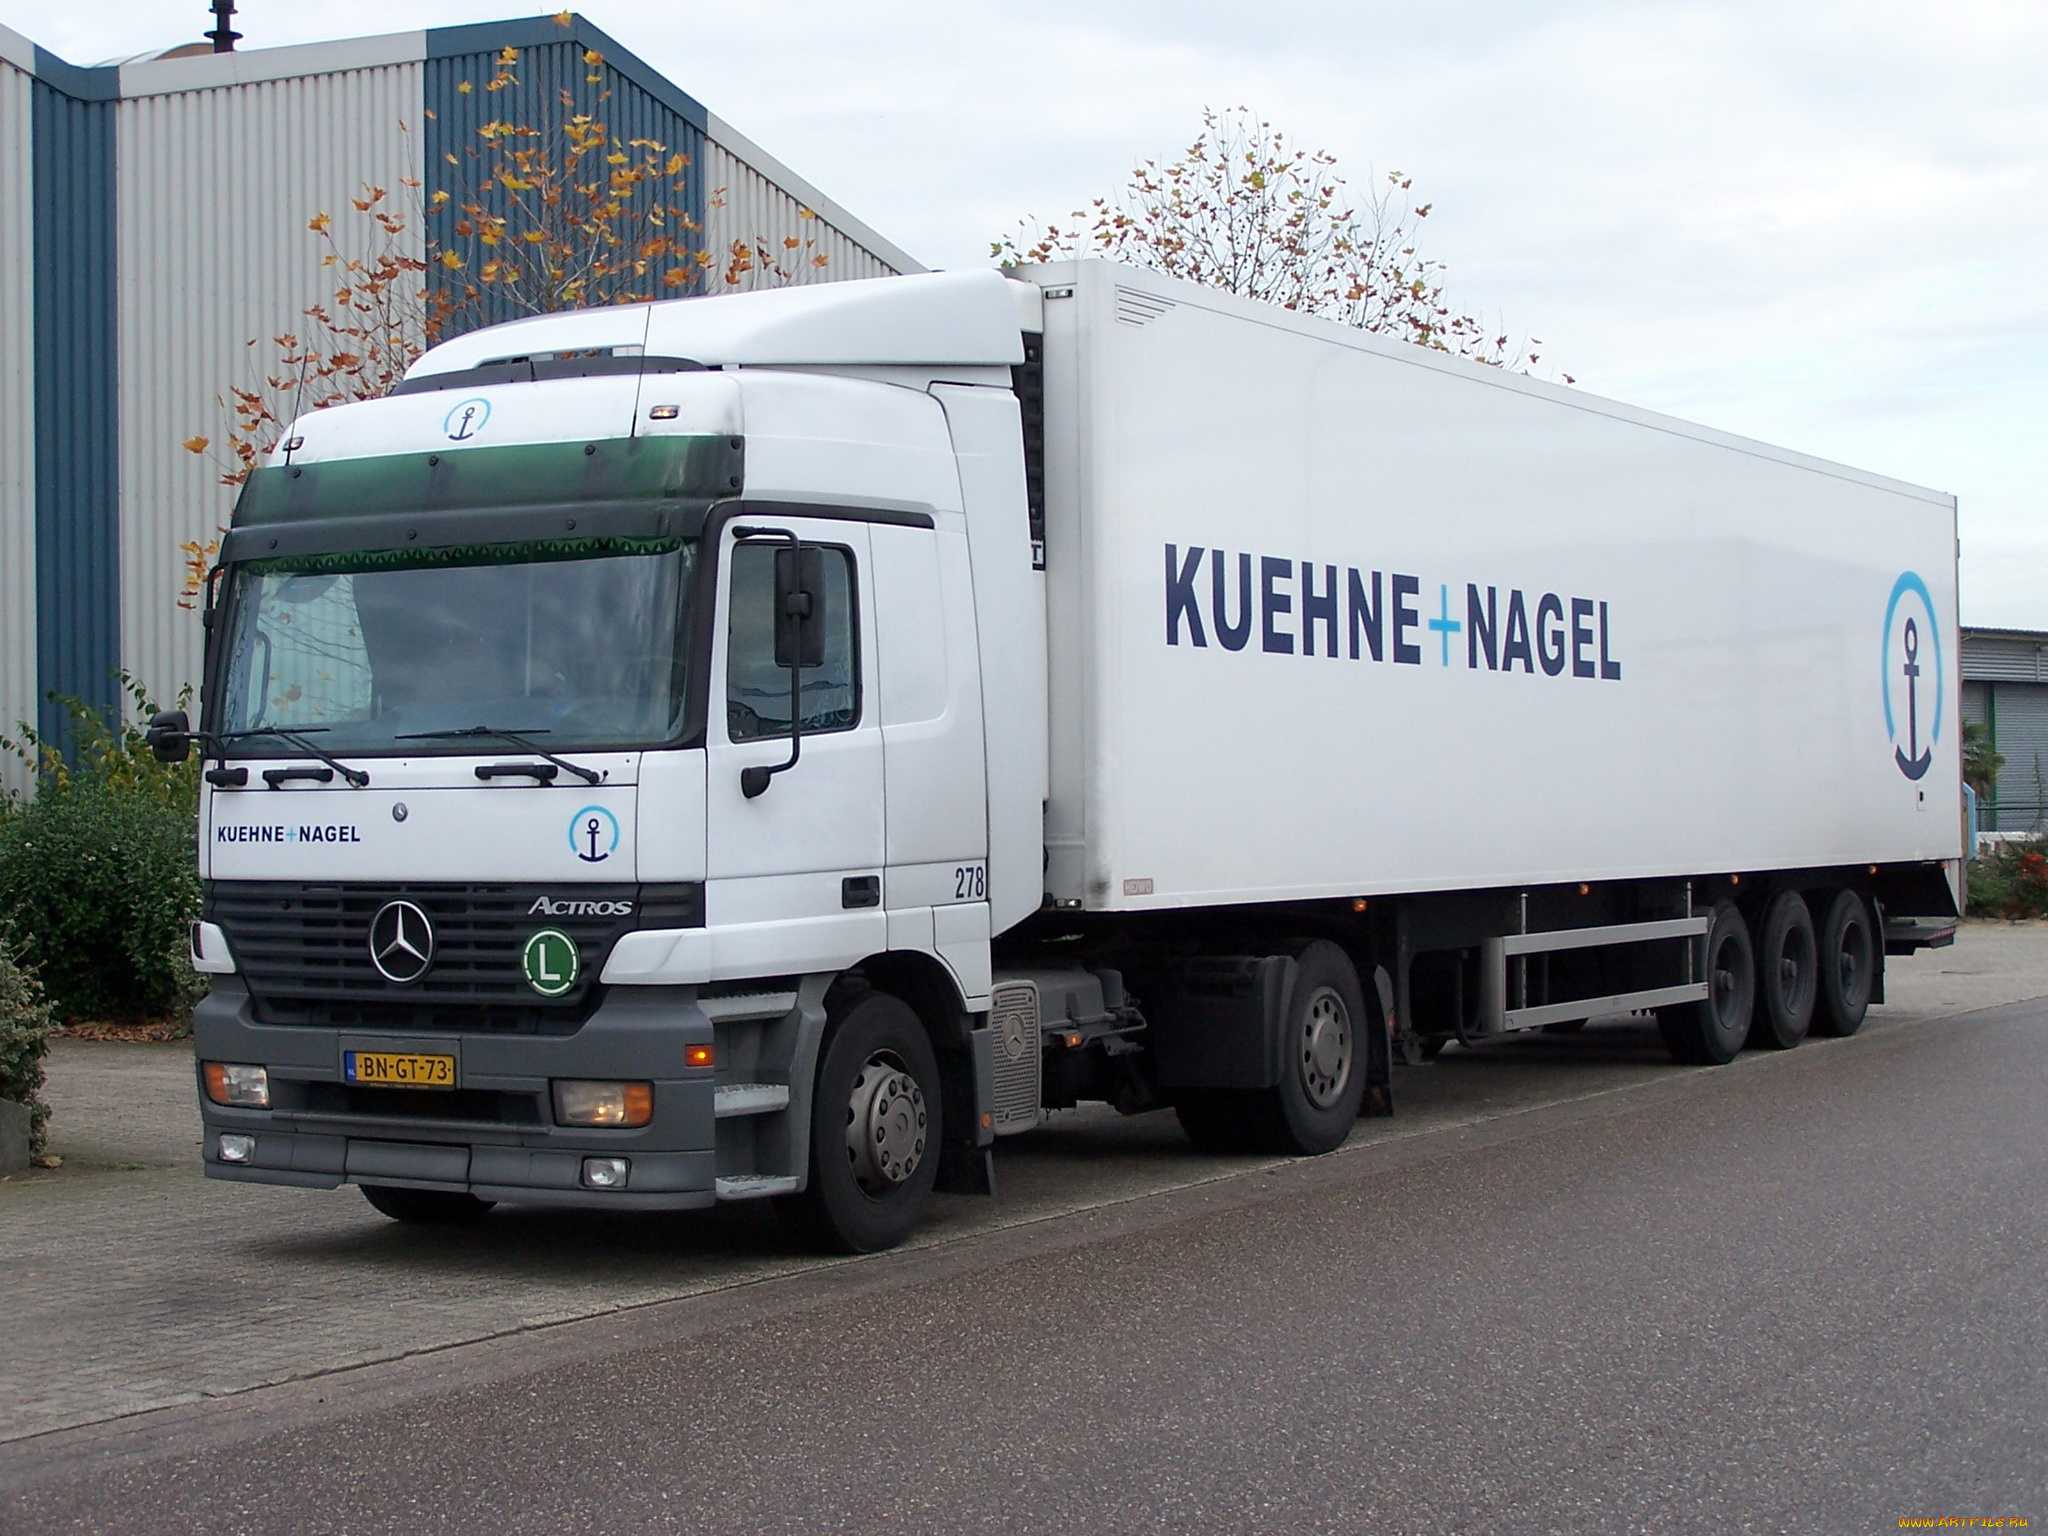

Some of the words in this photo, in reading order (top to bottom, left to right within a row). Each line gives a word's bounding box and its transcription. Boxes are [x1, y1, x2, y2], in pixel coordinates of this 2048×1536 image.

[1164, 543, 1622, 681] KUEHNE+NAGEL
[217, 825, 361, 842] KUEHNE+NAGEL
[955, 866, 984, 899] 278
[539, 943, 561, 981] L
[363, 1056, 449, 1080] BN-GT-73
